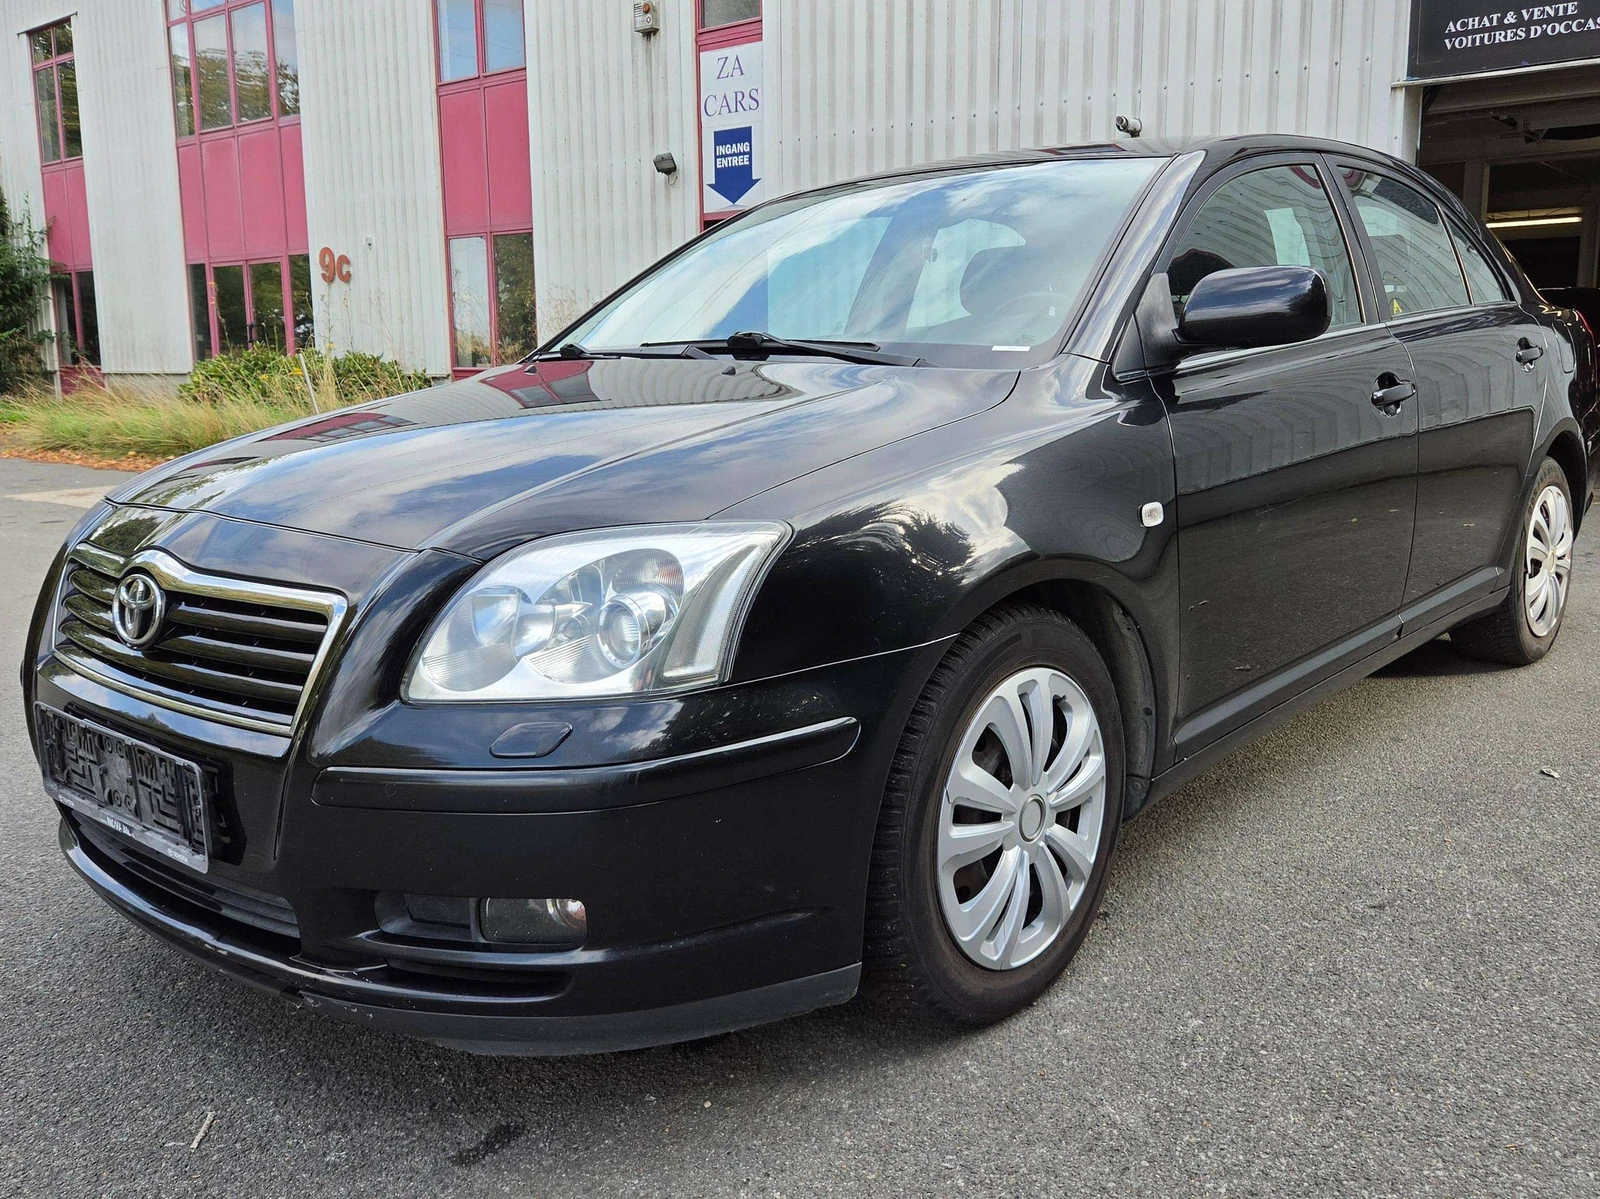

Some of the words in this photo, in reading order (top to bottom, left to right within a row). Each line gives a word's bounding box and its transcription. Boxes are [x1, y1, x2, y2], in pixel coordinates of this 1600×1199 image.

[1444, 13, 1501, 34] ACHAT
[1503, 11, 1517, 25] &
[1521, 1, 1578, 22] VENTE
[1444, 27, 1526, 50] VOITURES
[716, 54, 745, 80] ZA
[703, 88, 760, 117] CARS
[716, 141, 750, 156] INGANG
[716, 154, 750, 169] ENTREE
